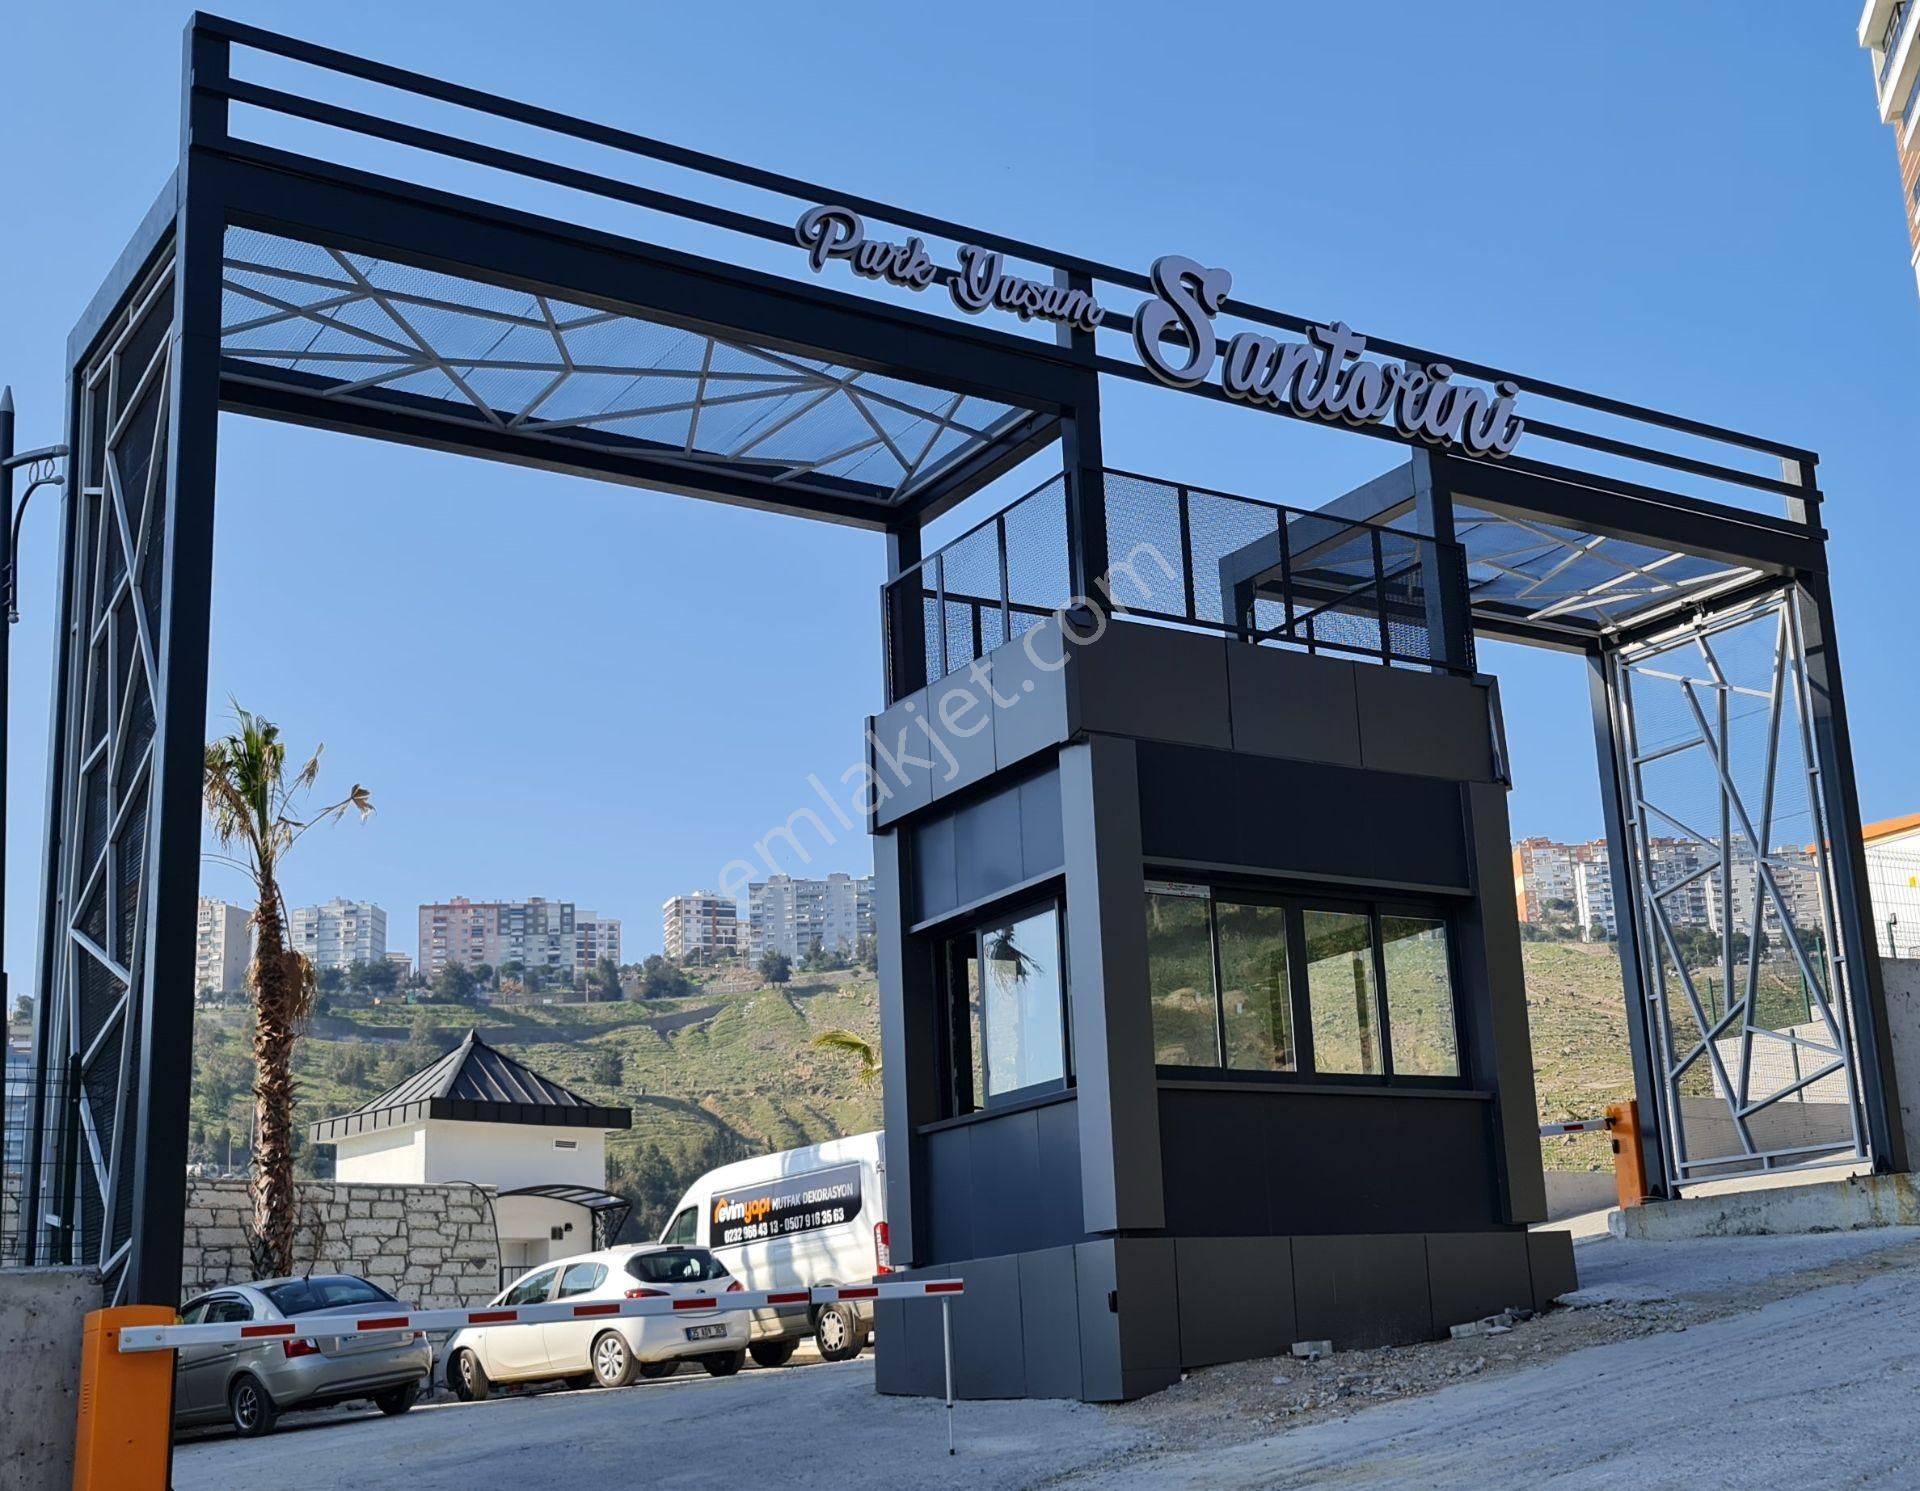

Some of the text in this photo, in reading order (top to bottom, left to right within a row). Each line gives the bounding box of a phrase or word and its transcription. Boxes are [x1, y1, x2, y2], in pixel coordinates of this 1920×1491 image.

[795, 204, 1106, 333] Park Yaşam
[1132, 254, 1525, 460] Santorini
[724, 1227, 743, 1244] 0232
[758, 1222, 768, 1236] 43
[769, 1220, 779, 1234] 13
[784, 1215, 804, 1231] 0507
[821, 1209, 833, 1224] 35
[833, 1207, 845, 1222] 63
[771, 1193, 801, 1211] MUTFAK
[802, 1182, 854, 1204] DEKORASYON
